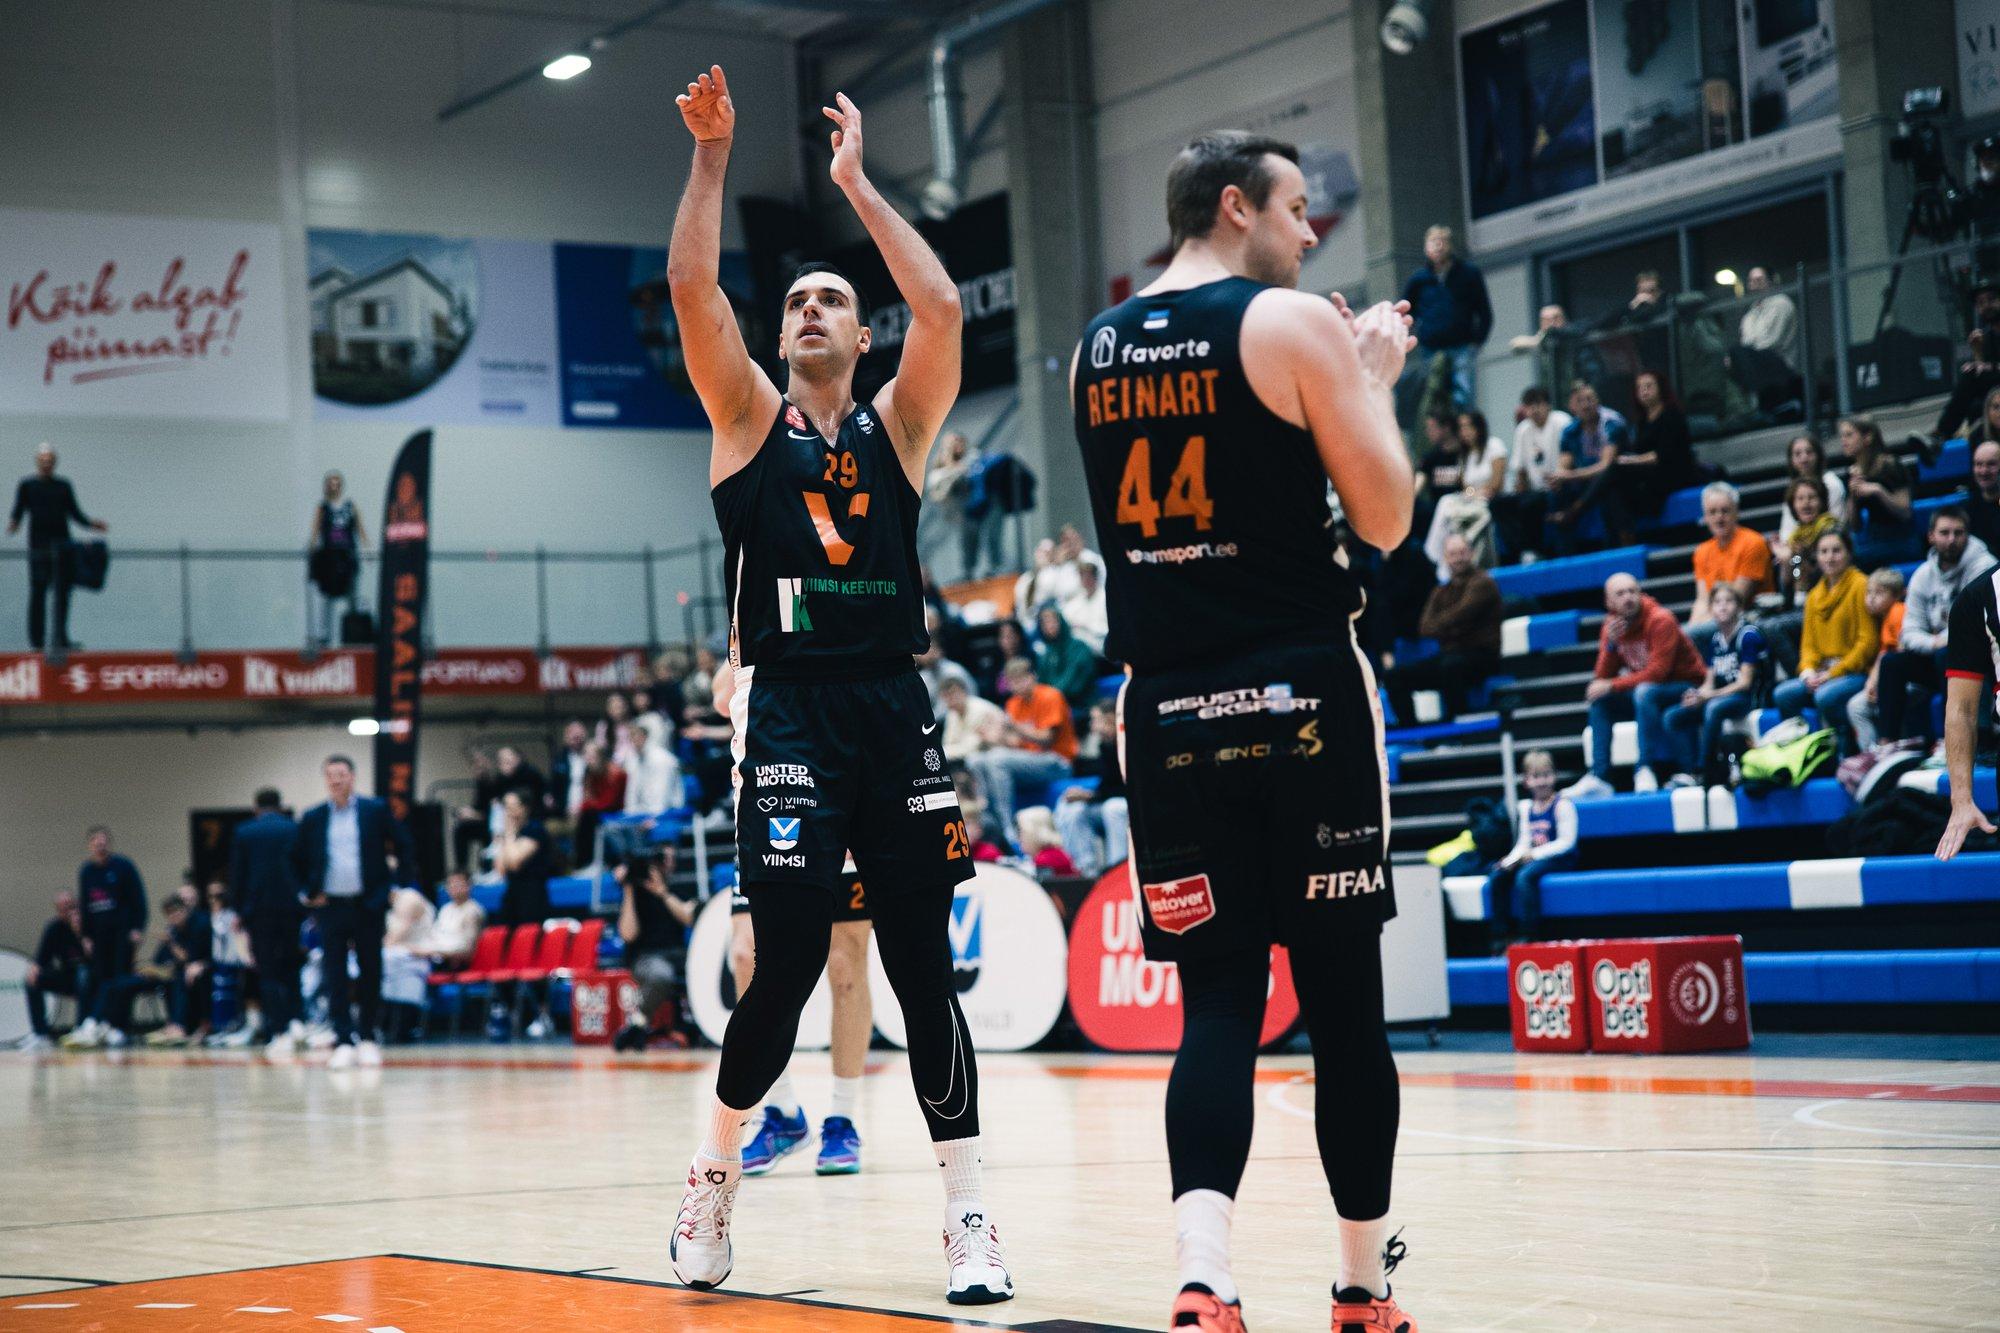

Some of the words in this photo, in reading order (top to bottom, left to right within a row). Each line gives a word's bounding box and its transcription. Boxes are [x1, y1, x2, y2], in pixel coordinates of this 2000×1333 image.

[1122, 339, 1210, 364] favorte
[1087, 369, 1220, 427] REINART
[823, 451, 859, 488] 29
[1116, 435, 1214, 539] 44
[802, 578, 839, 593] VIIMSI
[841, 581, 897, 596] KEEVITUS
[1157, 684, 1292, 715] SISUSTUS
[757, 774, 815, 788] MOTORS
[943, 820, 969, 861] 29
[762, 854, 806, 868] VIIMSI
[1305, 864, 1386, 900] FIFAA
[1515, 960, 1575, 1004] Opti
[1592, 958, 1652, 1003] Opti
[1526, 1001, 1572, 1039] bet
[1602, 1000, 1650, 1039] bet
